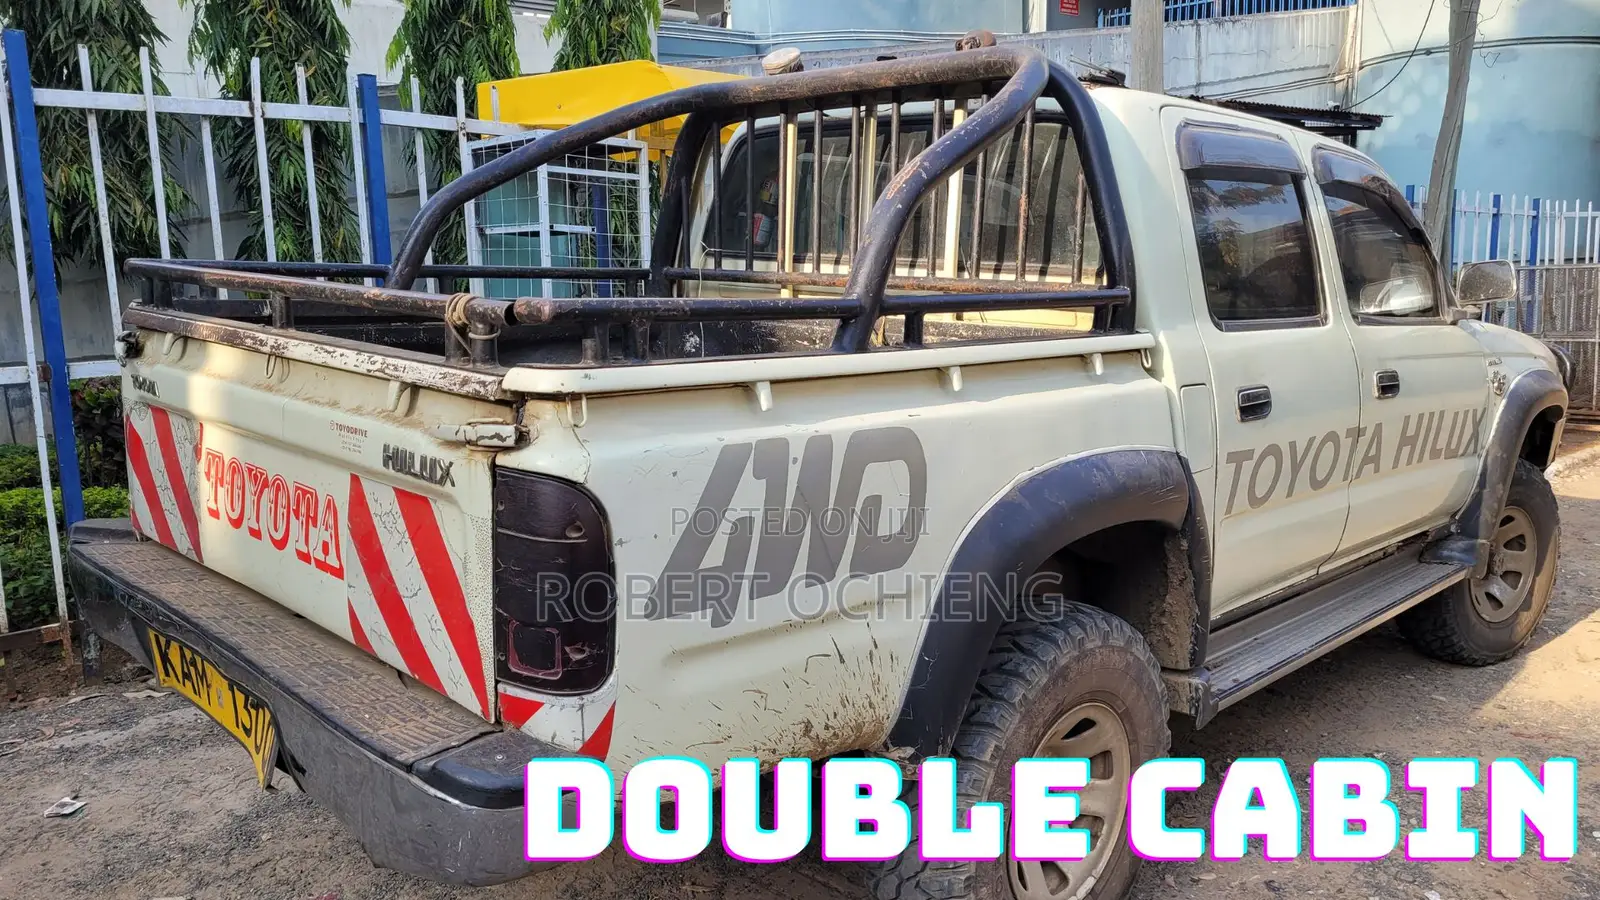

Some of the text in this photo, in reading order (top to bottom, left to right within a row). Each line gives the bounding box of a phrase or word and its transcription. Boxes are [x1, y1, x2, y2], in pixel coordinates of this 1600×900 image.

[335, 422, 368, 438] TOYODRIVE
[382, 442, 456, 487] HILUX
[1223, 408, 1487, 516] TOYOTA HILUX
[204, 447, 345, 581] TOYOTA
[643, 426, 928, 628] 4WD
[154, 633, 212, 707] KAM
